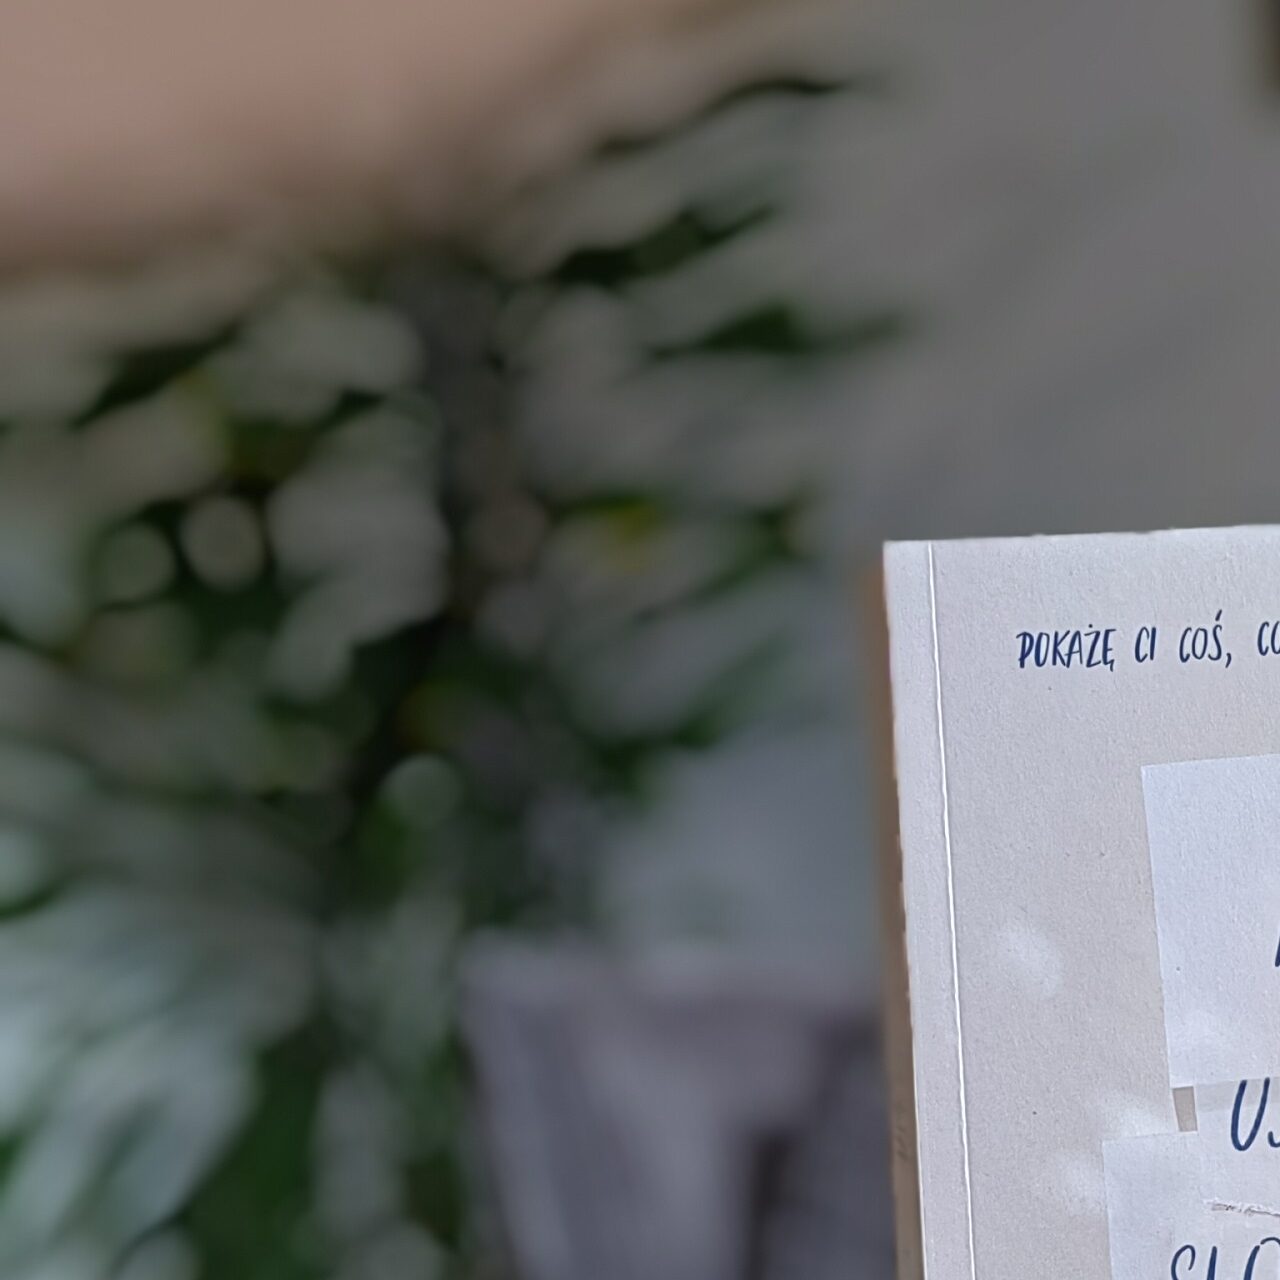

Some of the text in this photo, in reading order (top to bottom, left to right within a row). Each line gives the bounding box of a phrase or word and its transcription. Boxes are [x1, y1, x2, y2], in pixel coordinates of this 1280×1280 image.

[1016, 624, 1116, 672] POKAŻĘ
[1135, 627, 1156, 663] CI
[1179, 609, 1232, 669] COŚ,
